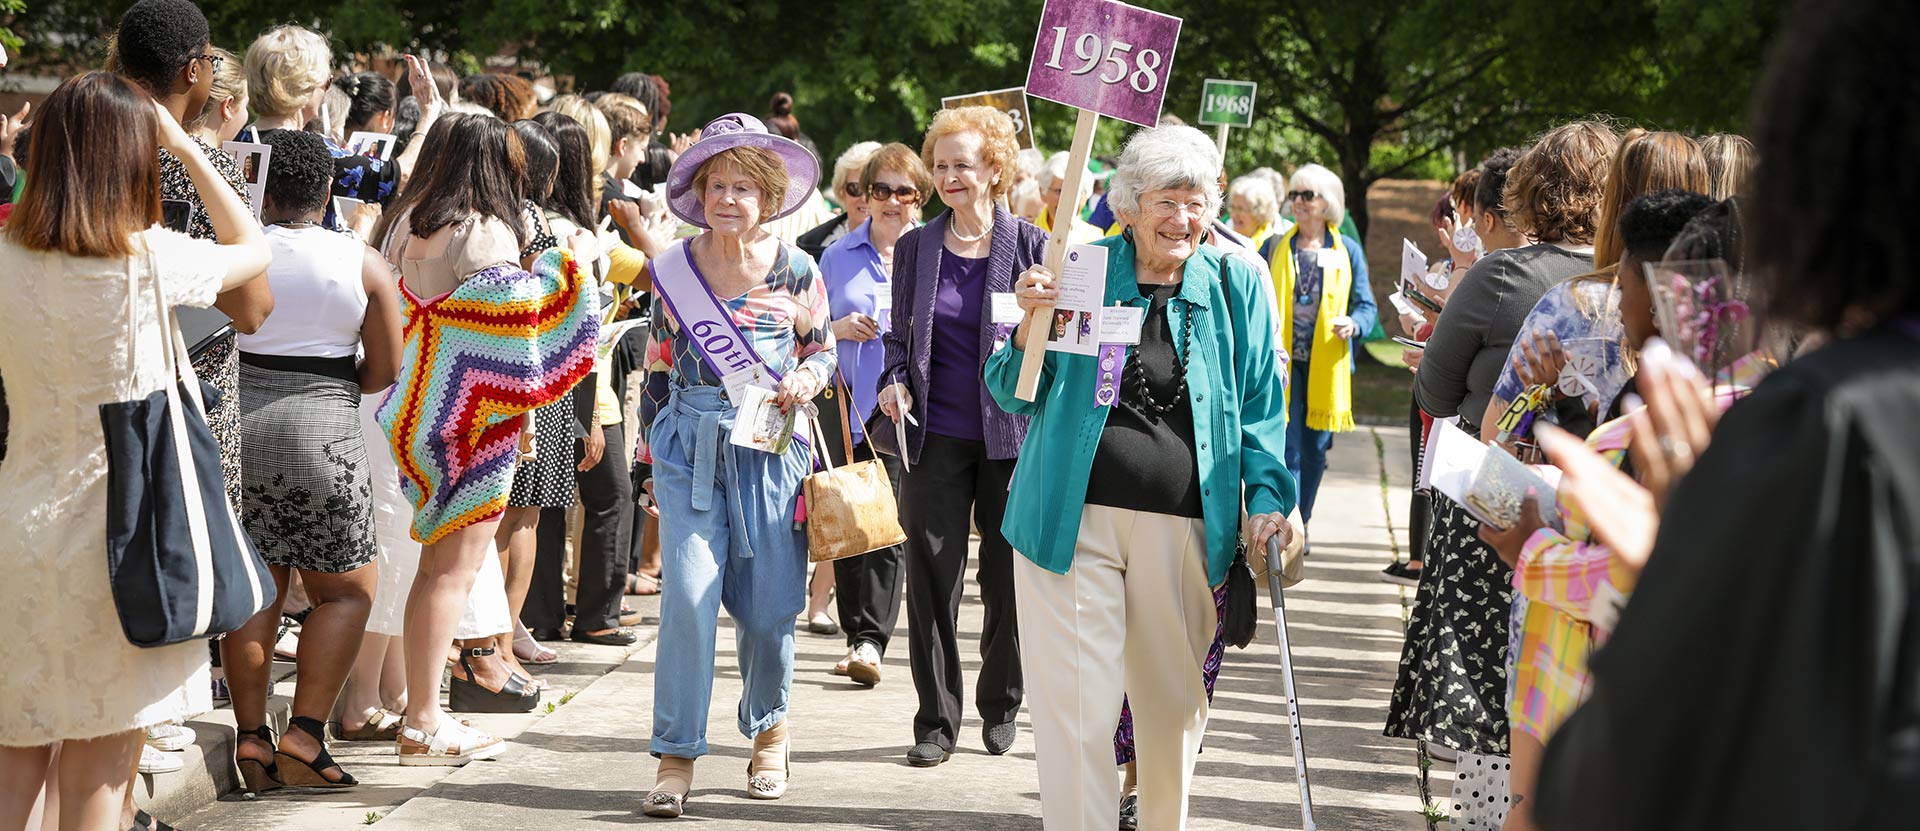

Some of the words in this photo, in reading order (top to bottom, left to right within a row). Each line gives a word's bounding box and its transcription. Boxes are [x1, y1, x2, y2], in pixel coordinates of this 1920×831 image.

[1044, 26, 1161, 93] 1958
[1206, 93, 1250, 115] 1968
[1497, 396, 1528, 430] R
